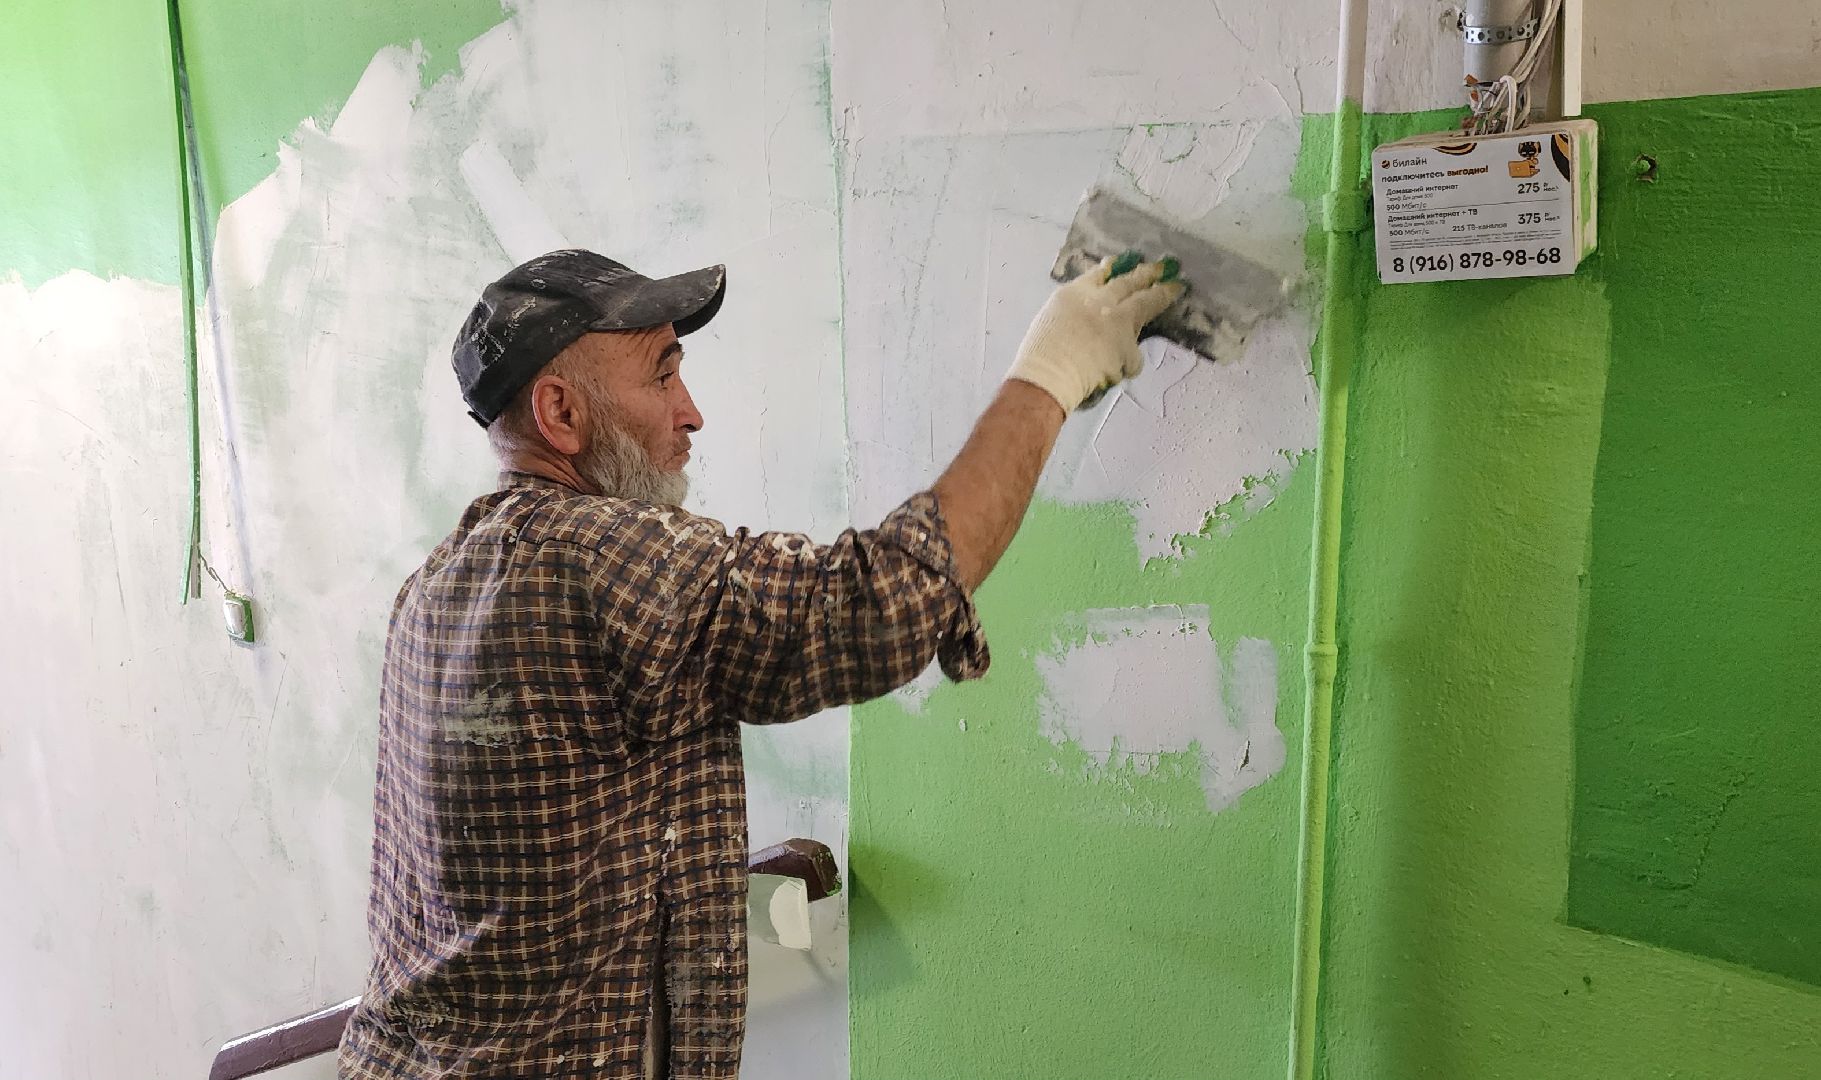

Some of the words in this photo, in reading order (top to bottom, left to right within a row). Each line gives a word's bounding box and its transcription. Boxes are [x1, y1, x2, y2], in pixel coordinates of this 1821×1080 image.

[1392, 156, 1427, 168] билайн
[1382, 170, 1444, 182] подключитесь
[1446, 165, 1488, 176] выгодно!
[1386, 186, 1424, 196] Домашний
[1518, 182, 1540, 194] 275
[1402, 202, 1427, 210] Мбит/с
[1388, 213, 1426, 223] Домашний
[1426, 211, 1460, 219] интернет
[1518, 212, 1542, 224] 375
[1404, 228, 1430, 236] Мбит/с
[1467, 222, 1508, 230] ТВ-каналов
[1392, 257, 1404, 273] 8
[1409, 253, 1454, 275] (916)
[1459, 247, 1562, 270] 878-98-68
